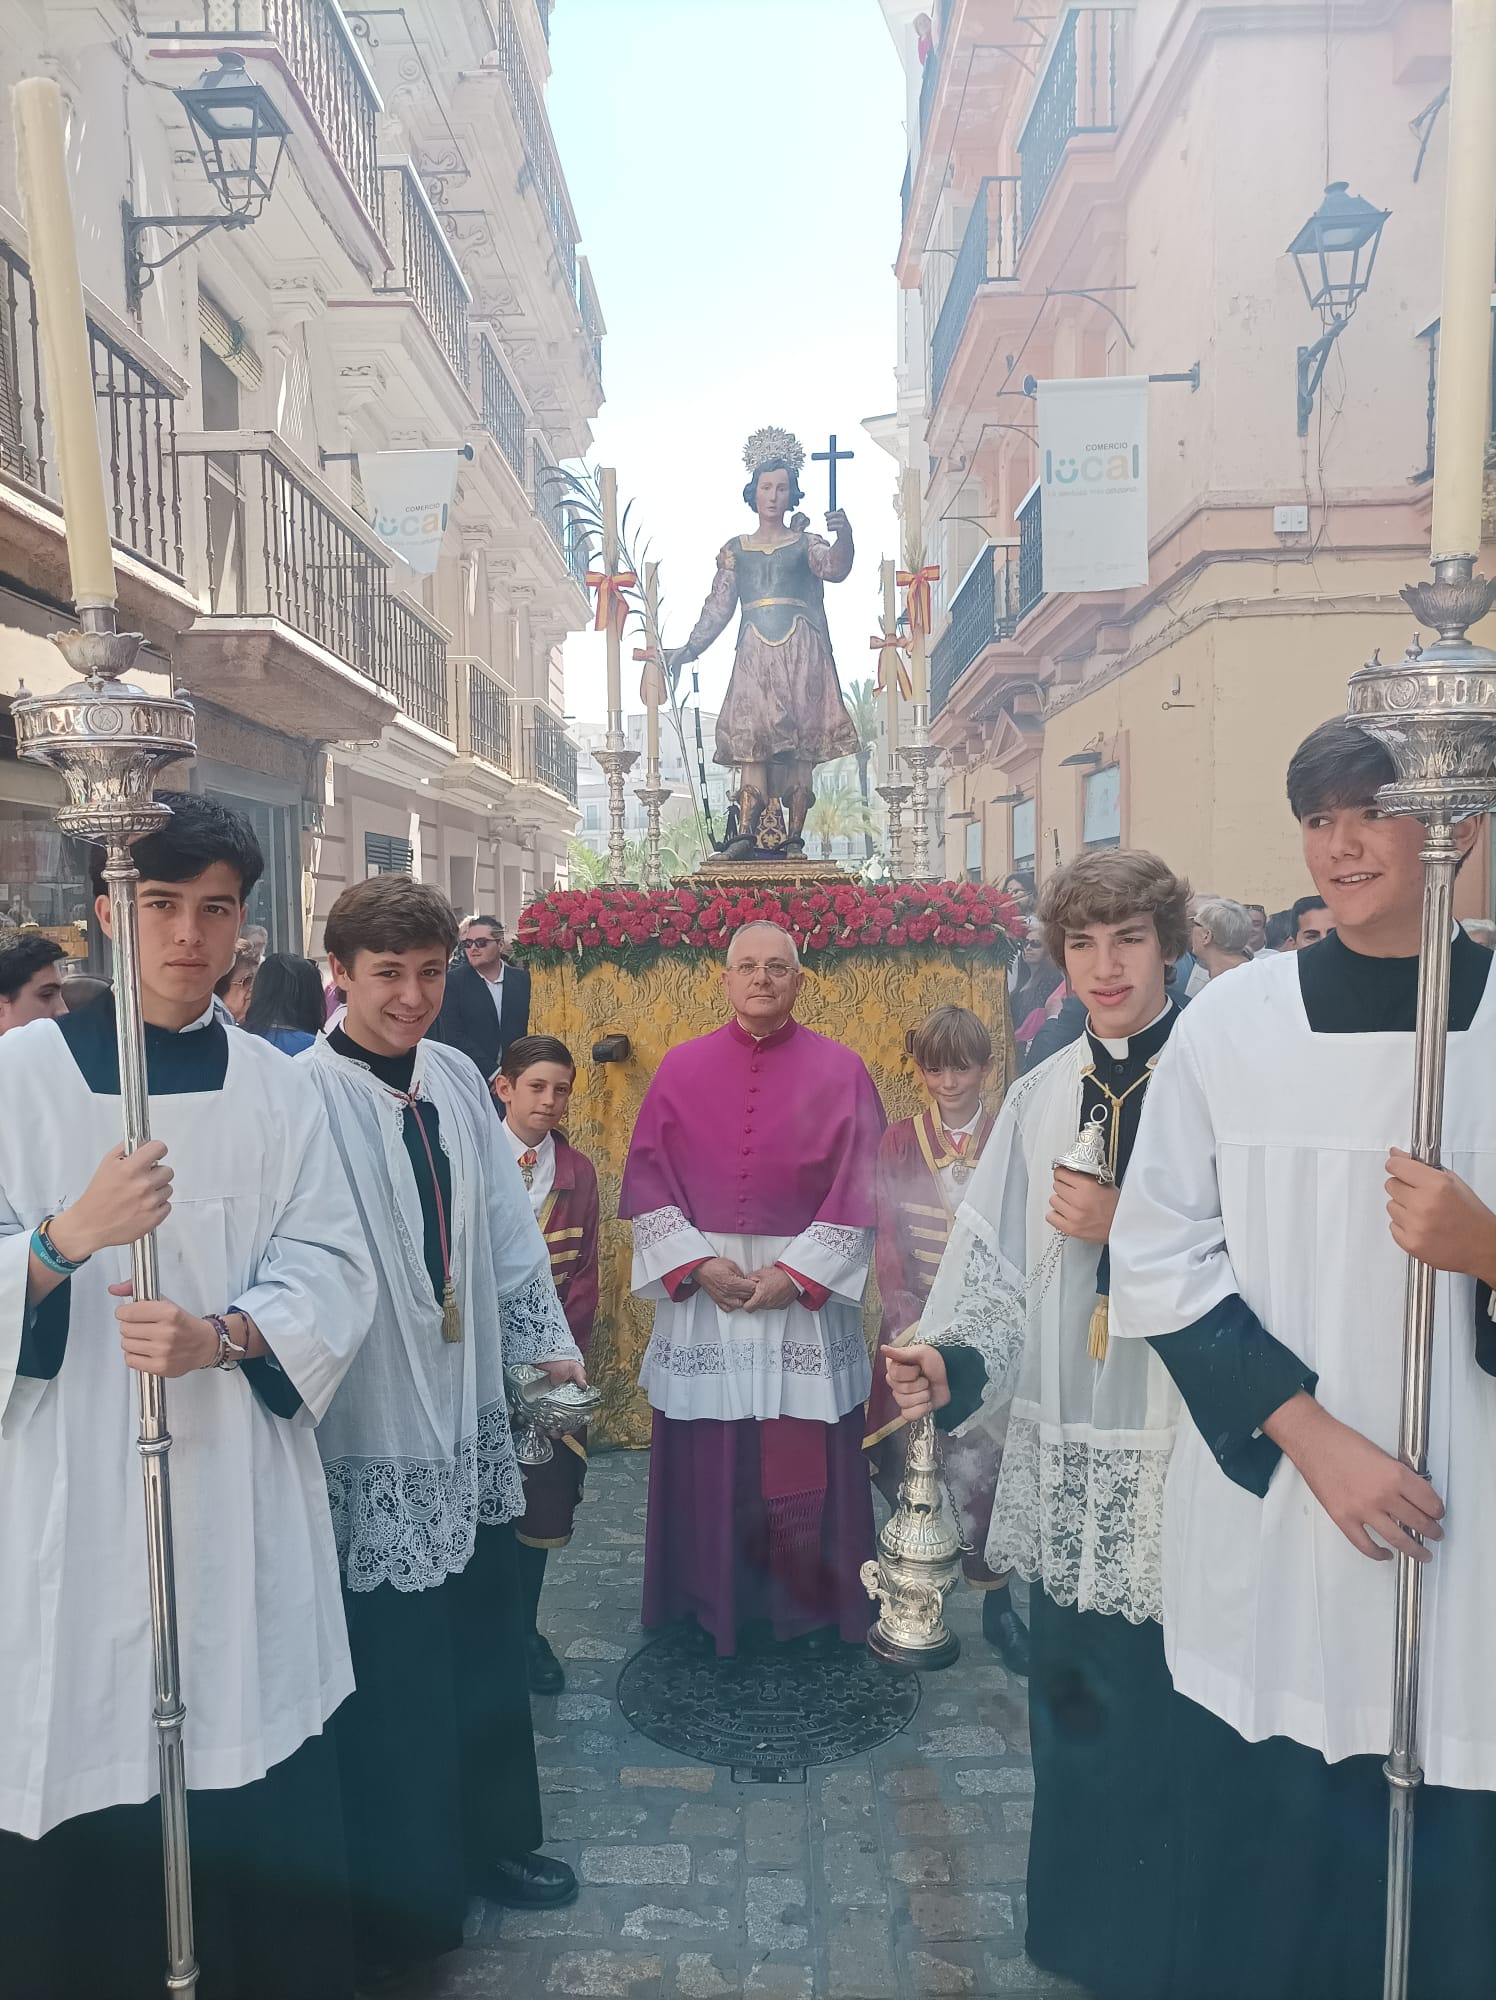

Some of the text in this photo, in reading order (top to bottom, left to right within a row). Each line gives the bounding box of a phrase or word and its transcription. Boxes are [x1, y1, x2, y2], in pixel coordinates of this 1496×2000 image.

[1085, 442, 1128, 451] COMERCIO
[405, 502, 440, 513] COMERCIO
[709, 1714, 818, 1734] SANEAMIENTO
